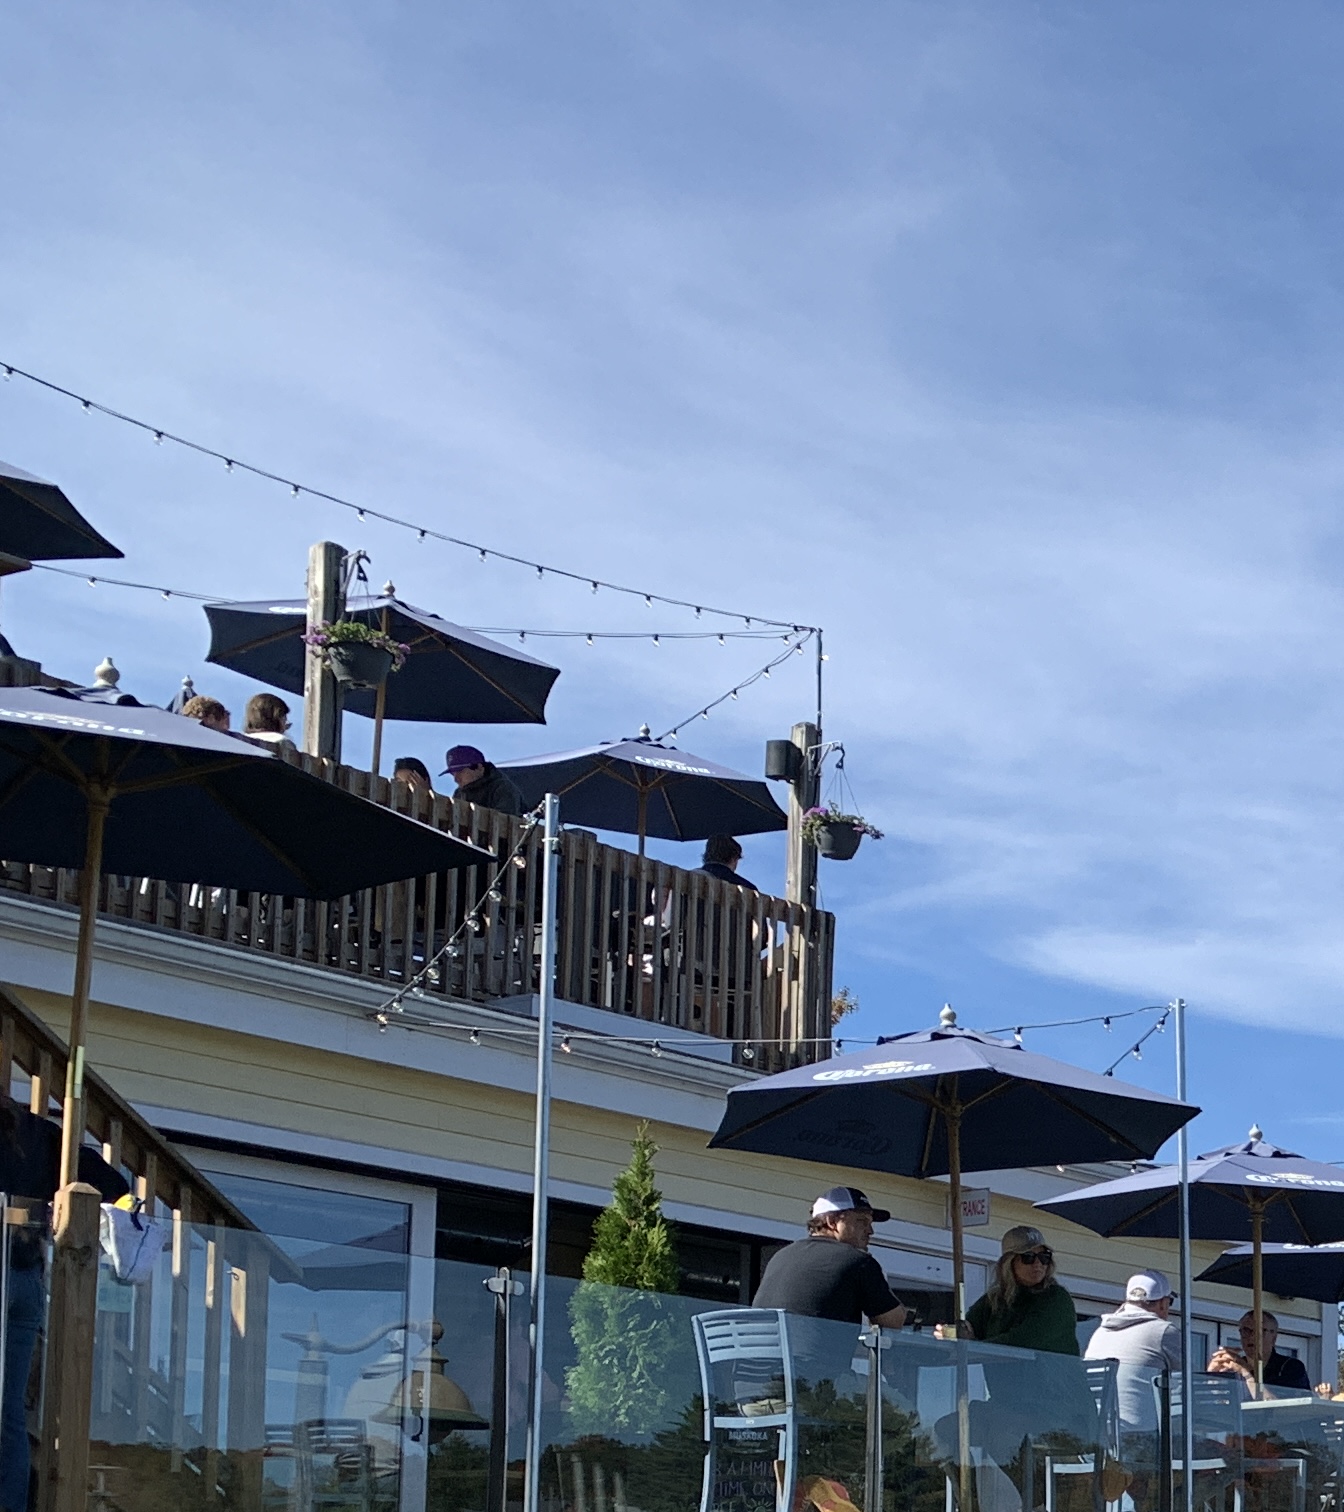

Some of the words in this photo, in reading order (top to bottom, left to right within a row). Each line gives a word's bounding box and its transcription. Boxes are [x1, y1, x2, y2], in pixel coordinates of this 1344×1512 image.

[0, 710, 144, 736] orona
[813, 1063, 932, 1081] Corona
[728, 1430, 768, 1441] MUSKOKA
